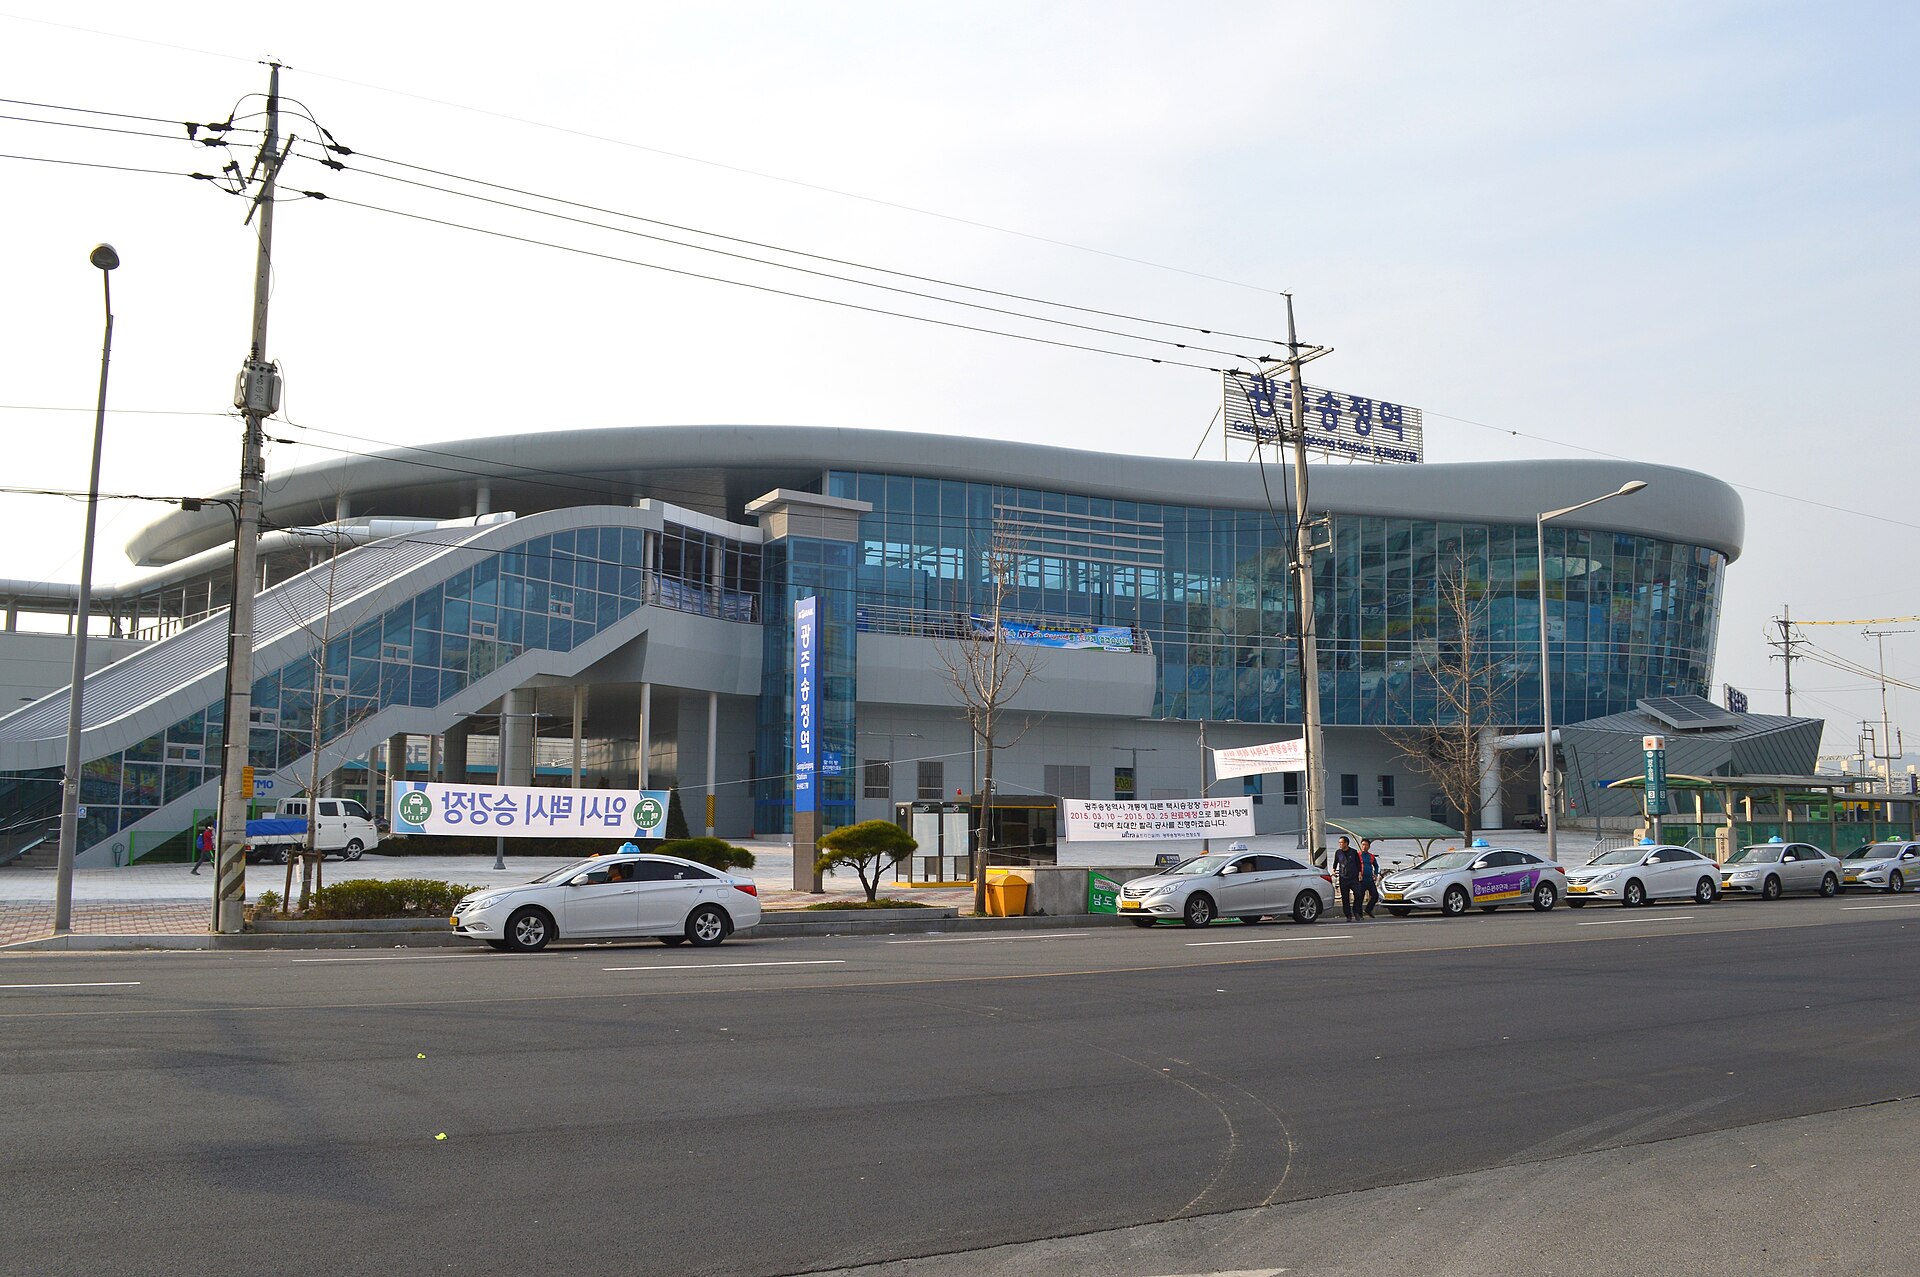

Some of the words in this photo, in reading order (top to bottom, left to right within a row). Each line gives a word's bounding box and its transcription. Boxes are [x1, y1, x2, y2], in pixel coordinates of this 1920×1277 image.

[800, 624, 811, 754] 광주송정역
[1084, 802, 1126, 811] 광주송정역사
[1127, 802, 1148, 811] 개통에
[1149, 802, 1163, 811] 따른
[1165, 801, 1201, 810] 택시승강장
[1202, 800, 1231, 809] 공사기간
[1070, 812, 1091, 820] 2015.
[1092, 812, 1104, 820] 03.
[1124, 812, 1145, 820] 2015.
[1146, 812, 1158, 820] 03.
[1159, 812, 1169, 820] 25
[1170, 810, 1212, 820] 완료예정으로
[1213, 808, 1249, 818] 불편사항에
[1093, 821, 1114, 830] 대하여
[1116, 821, 1137, 830] 최대한
[1154, 821, 1175, 830] 공사를
[1176, 819, 1228, 829] 진행하겠습니다.
